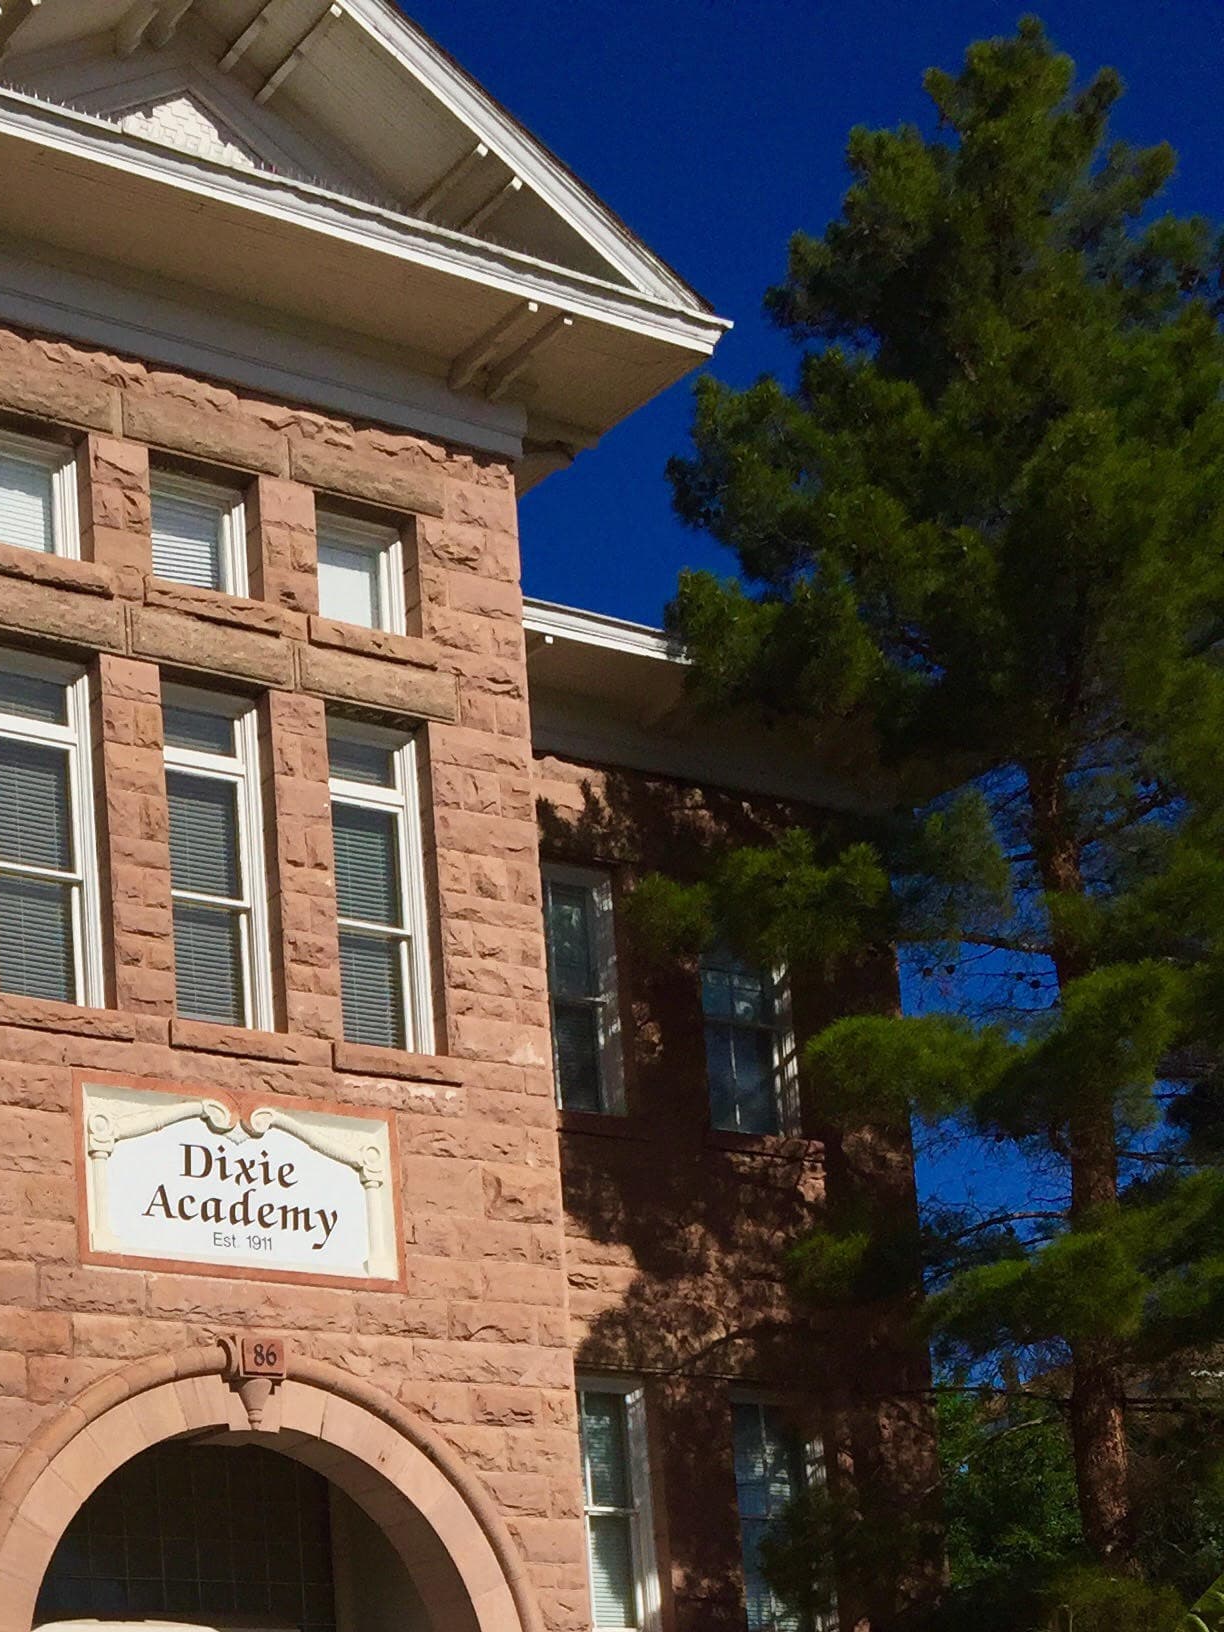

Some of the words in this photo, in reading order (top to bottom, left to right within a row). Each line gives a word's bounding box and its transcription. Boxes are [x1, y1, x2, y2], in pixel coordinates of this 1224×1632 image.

[179, 1143, 298, 1189] Dixie
[142, 1184, 338, 1250] Academy
[246, 1235, 273, 1251] 1911
[253, 1343, 278, 1367] 86
